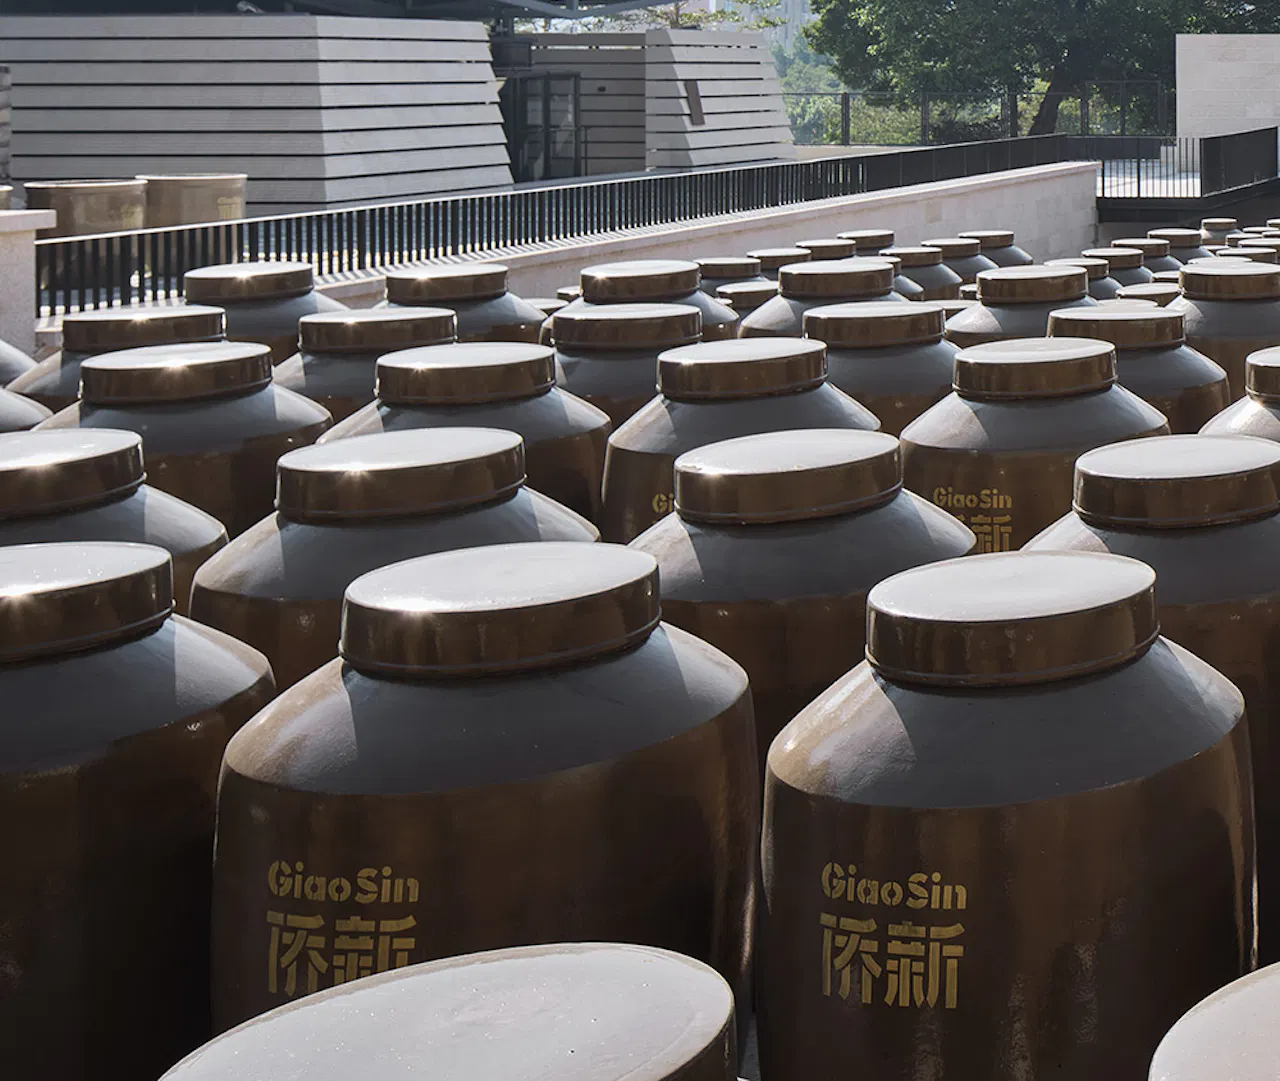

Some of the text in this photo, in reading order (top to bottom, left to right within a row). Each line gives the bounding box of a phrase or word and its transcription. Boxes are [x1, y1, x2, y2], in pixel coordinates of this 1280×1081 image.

[268, 860, 420, 904] GiaoSin
[821, 862, 967, 909] GiaoSin
[820, 912, 965, 1009] 侨新
